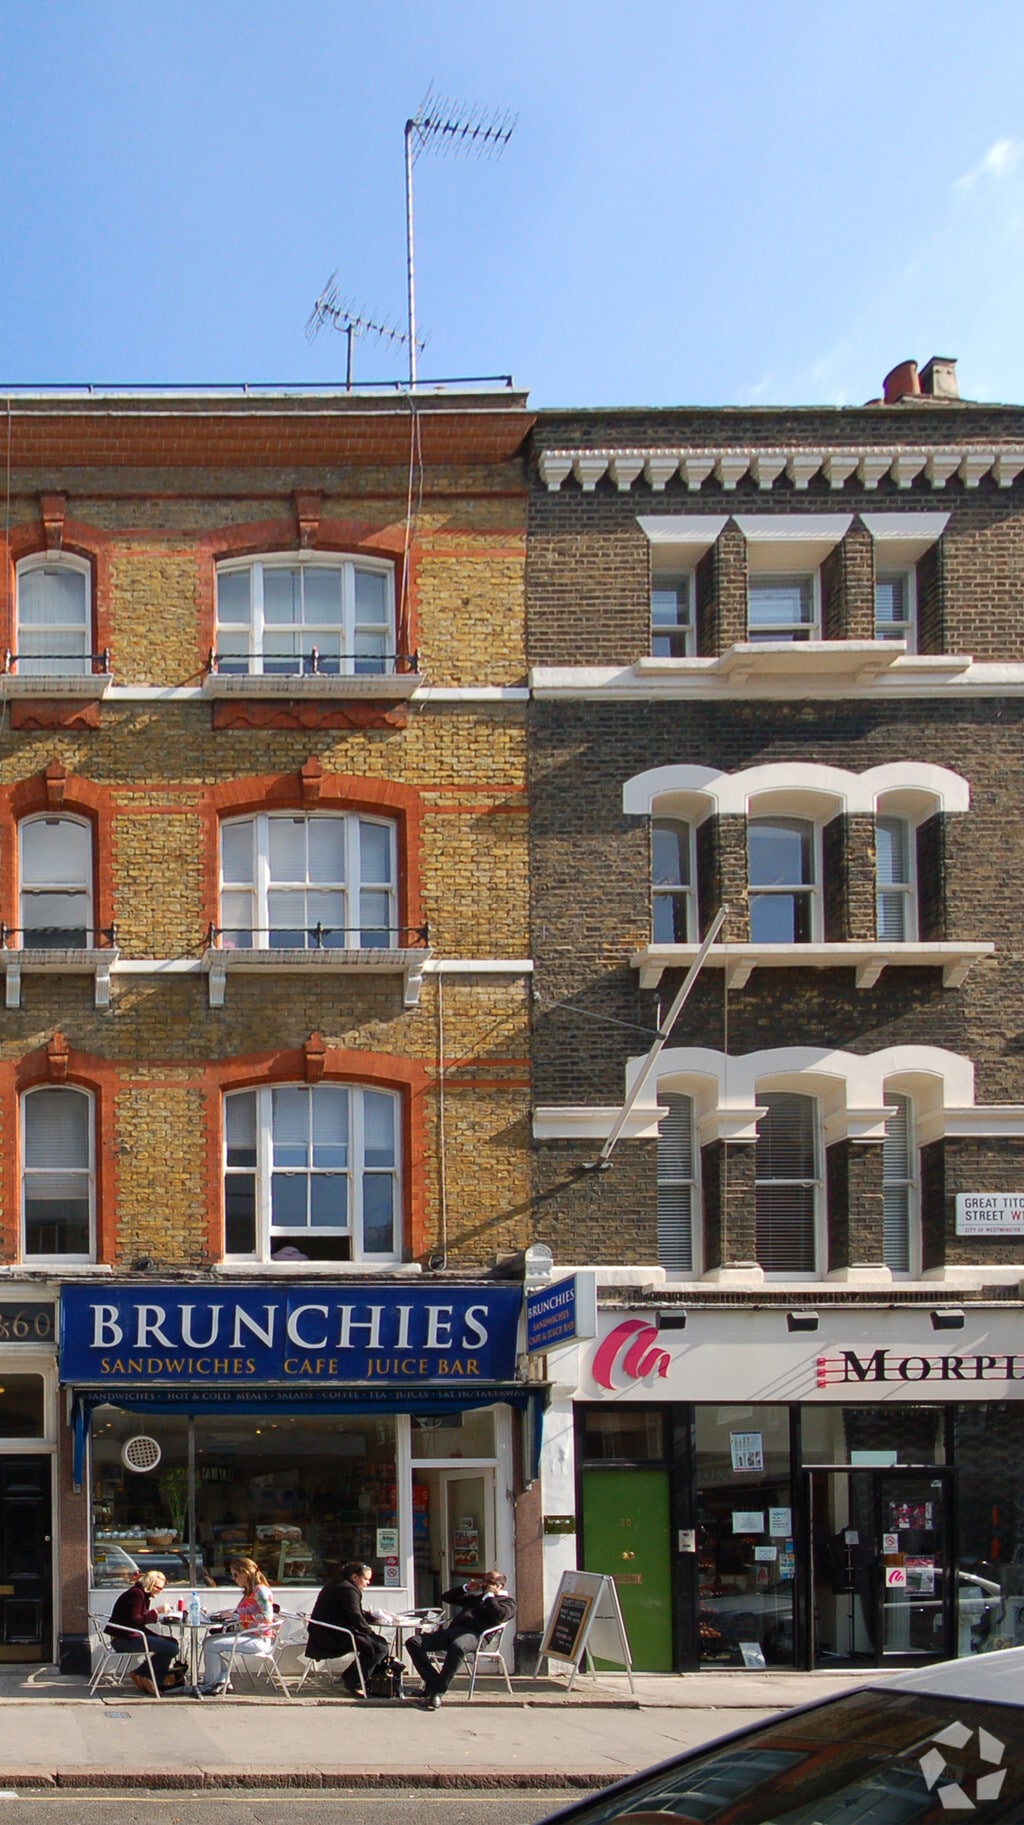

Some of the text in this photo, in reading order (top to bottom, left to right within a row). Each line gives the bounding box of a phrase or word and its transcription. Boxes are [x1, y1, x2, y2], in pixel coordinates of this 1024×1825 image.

[965, 1198, 997, 1208] GREAT
[965, 1211, 1004, 1220] STREET
[527, 1288, 575, 1319] BRUNCHIES
[89, 1304, 488, 1349] BRUNCHIES
[100, 1358, 480, 1377] SANDWICHES CAFE JUICE BAR
[88, 1392, 155, 1400] SANDWICHES
[167, 1392, 189, 1400] HOT
[202, 1392, 231, 1400] COLD
[236, 1391, 268, 1400] MEALS
